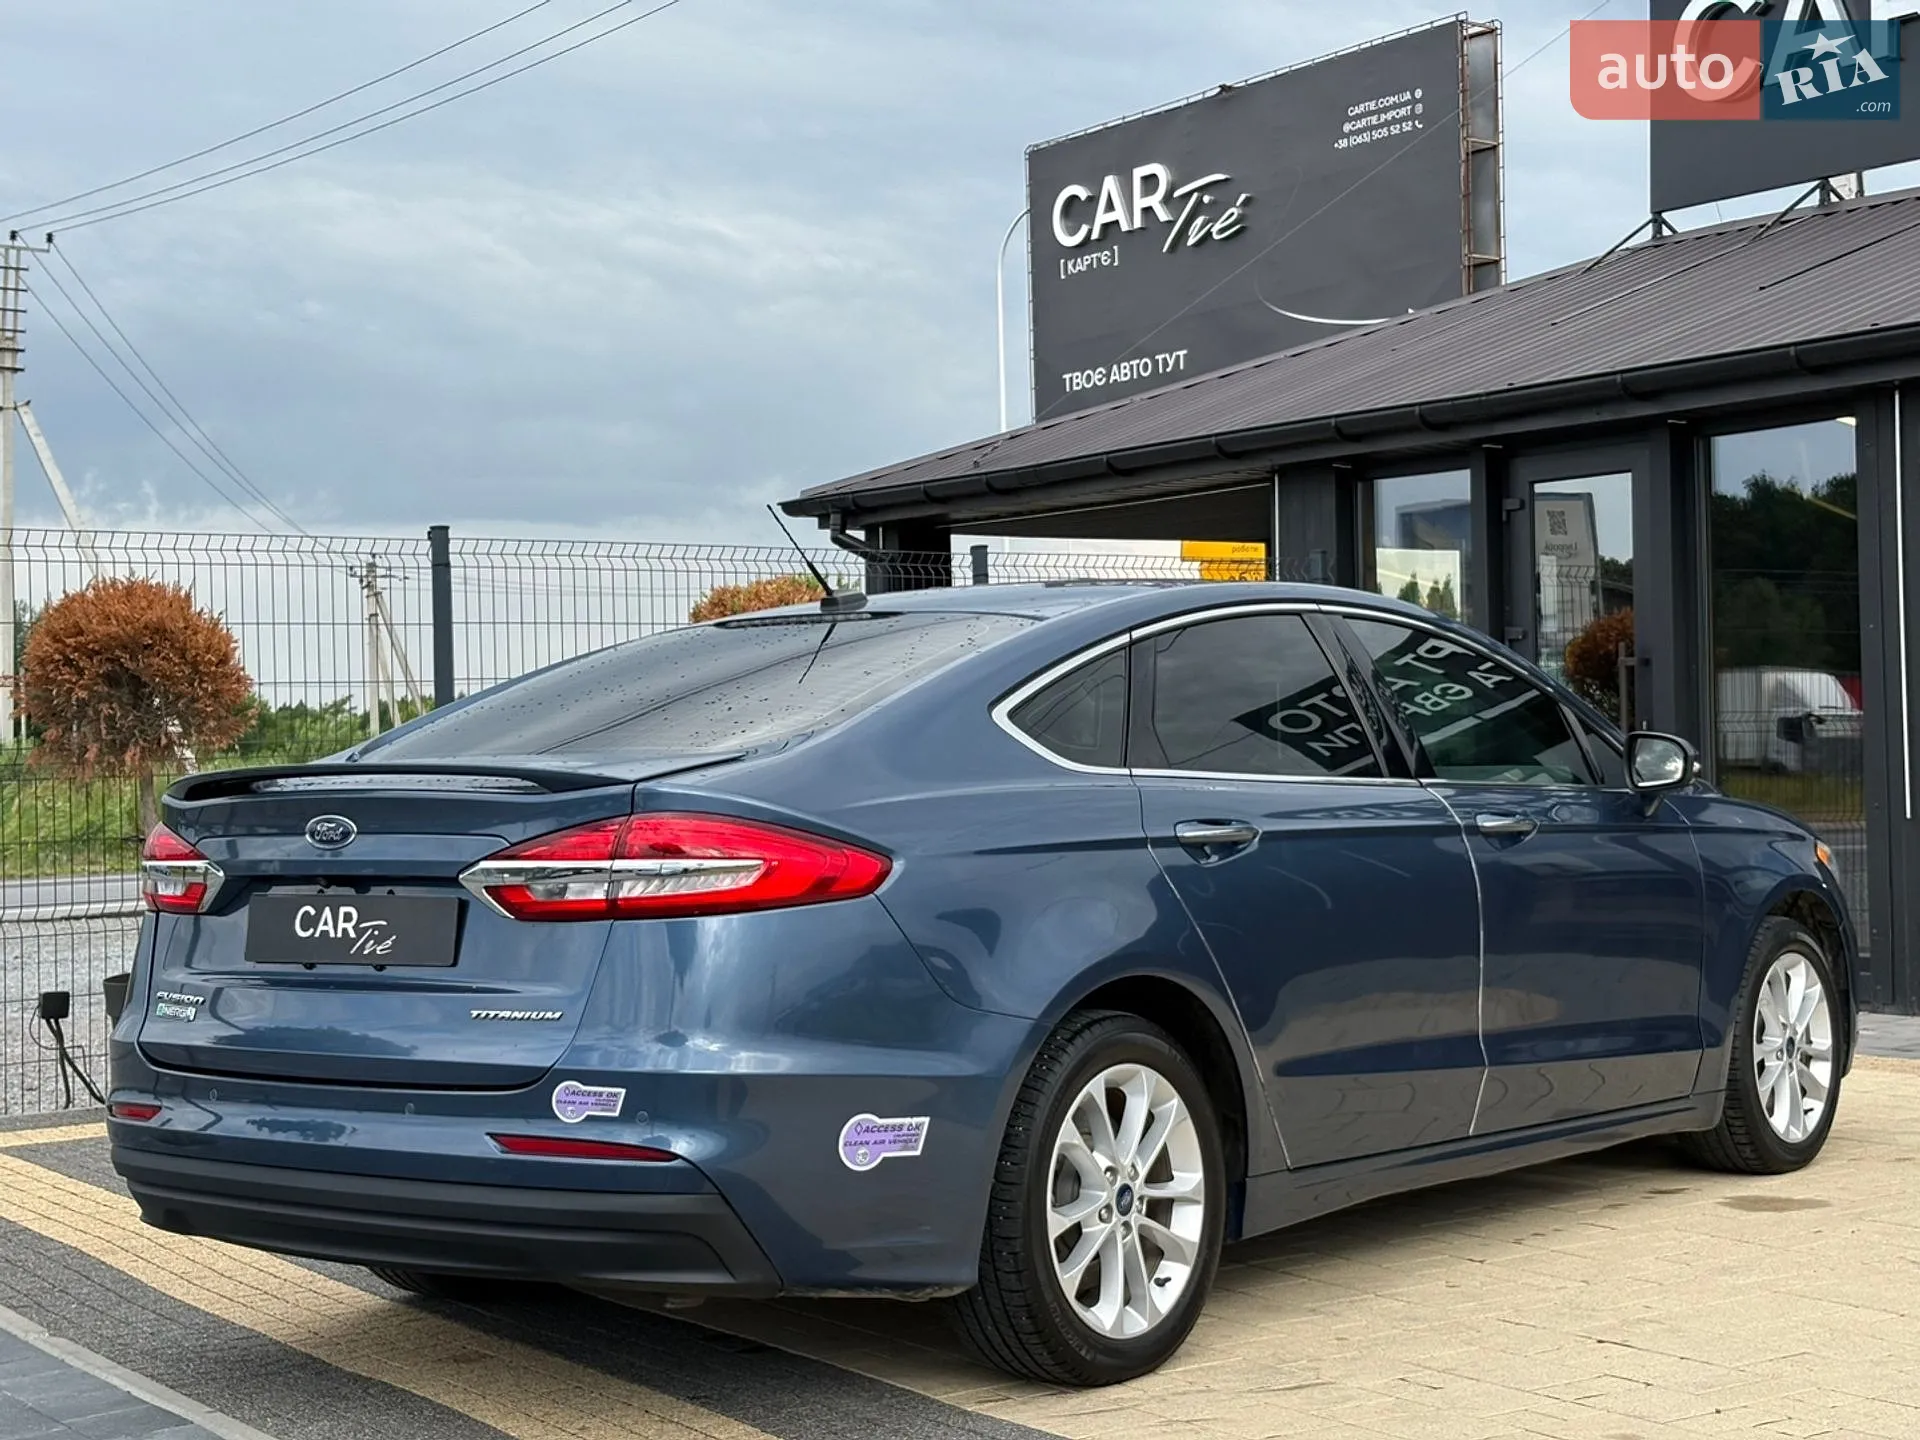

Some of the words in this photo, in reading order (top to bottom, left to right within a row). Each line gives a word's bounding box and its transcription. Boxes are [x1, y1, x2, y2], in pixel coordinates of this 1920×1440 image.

[1347, 91, 1412, 116] CARTIE.COM.UA
[1342, 105, 1412, 133] @CARTIE.IMPORT
[1334, 137, 1348, 149] +38
[1349, 131, 1371, 147] (063)
[1371, 127, 1389, 140] 505
[1389, 124, 1401, 135] 52
[1402, 121, 1413, 132] 52
[1062, 366, 1107, 393] ТВОЄ
[1109, 357, 1152, 385] АВТО
[1155, 349, 1188, 374] ТУТ
[314, 822, 343, 841] Ford
[470, 1010, 563, 1020] TITANIUM
[570, 1090, 604, 1098] ACCESS
[606, 1091, 619, 1099] OK
[863, 1123, 904, 1134] ACCESS
[906, 1123, 922, 1132] OK
[844, 1139, 871, 1147] CLEAN
[871, 1138, 886, 1146] AIR
